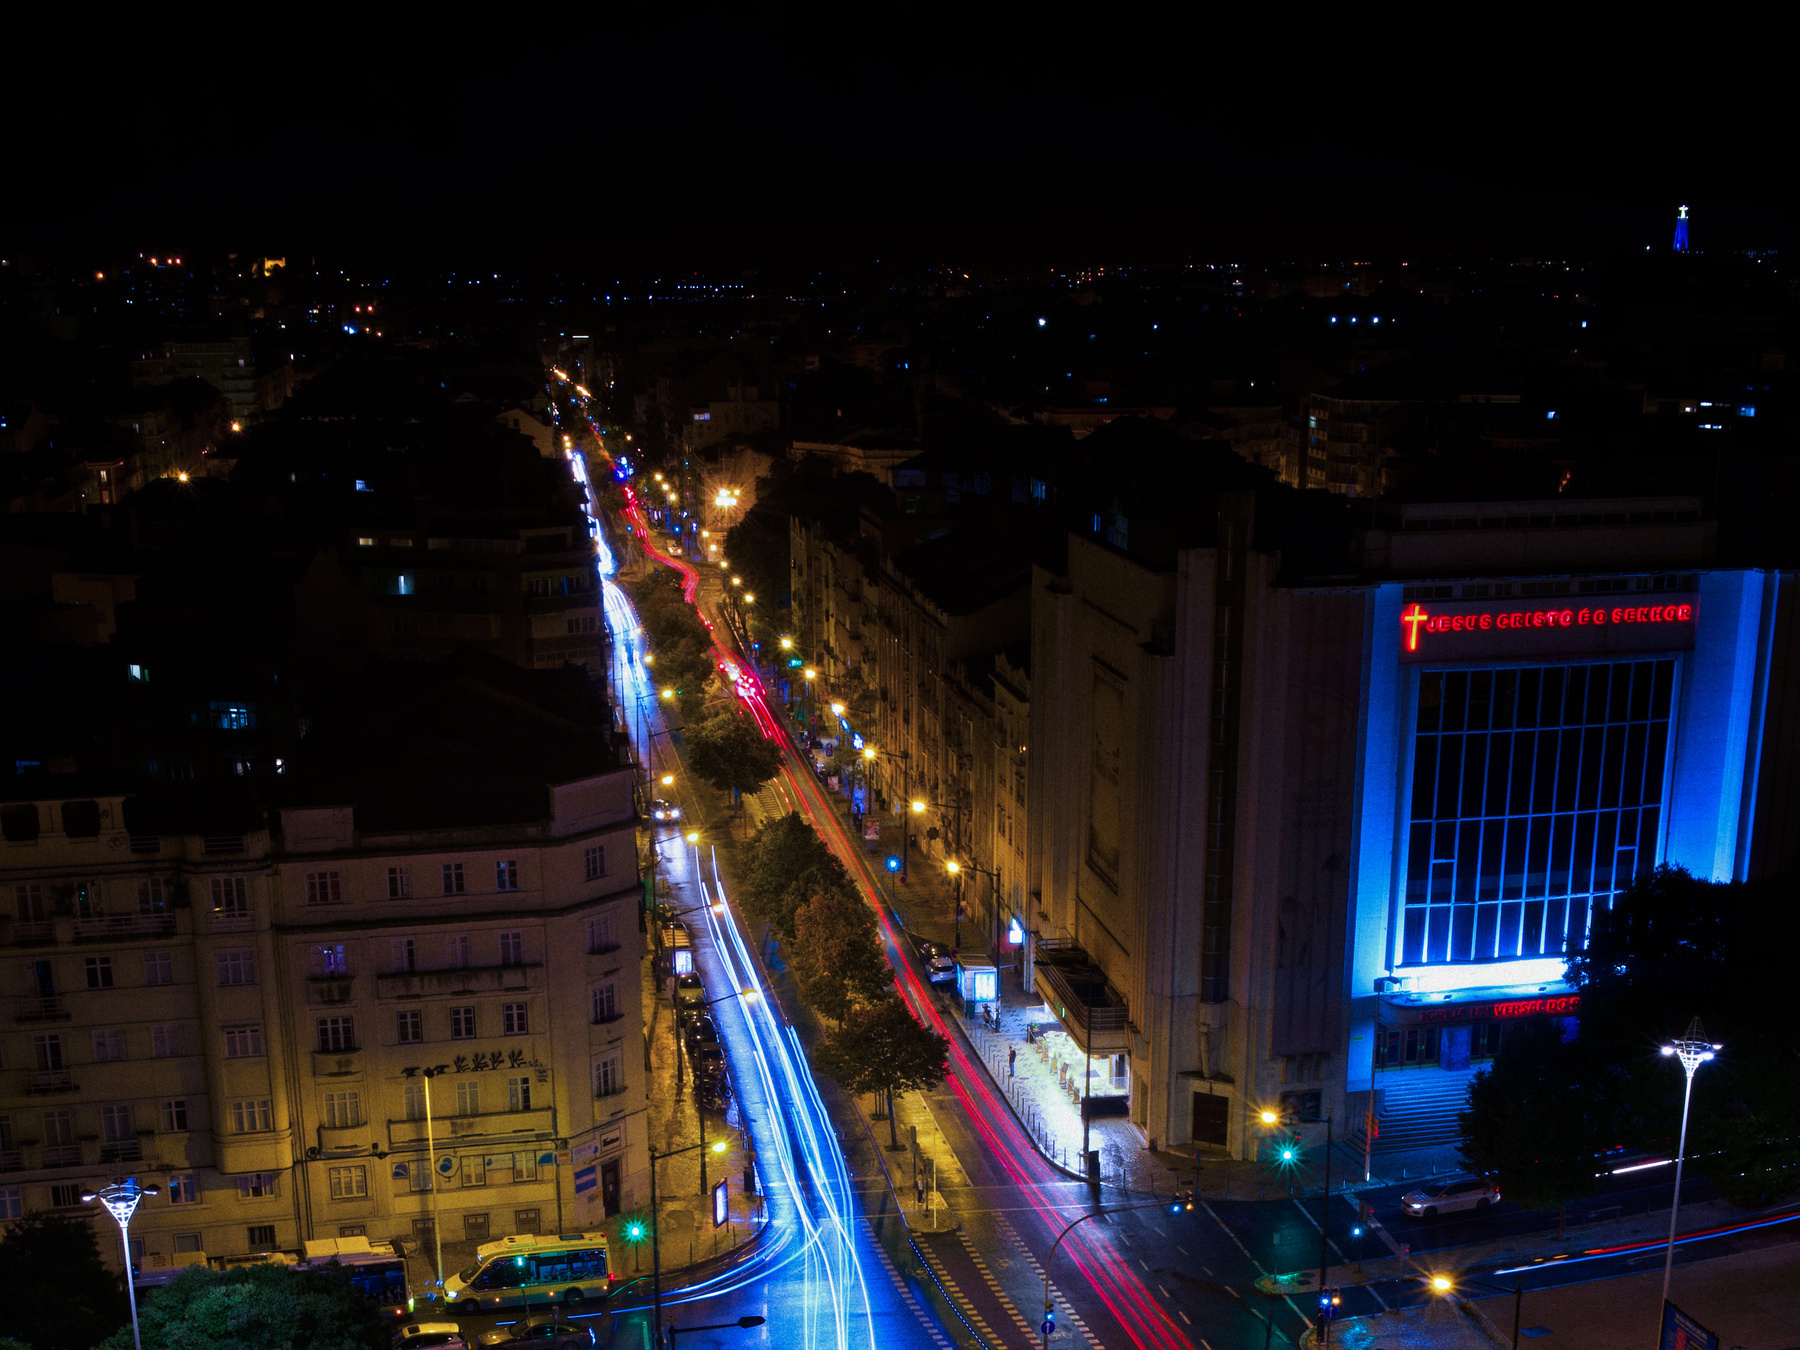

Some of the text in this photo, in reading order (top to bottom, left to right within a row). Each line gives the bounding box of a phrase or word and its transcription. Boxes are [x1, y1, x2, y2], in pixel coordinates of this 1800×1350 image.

[1426, 605, 1691, 632] JESUS CRISTO É O SENHOR
